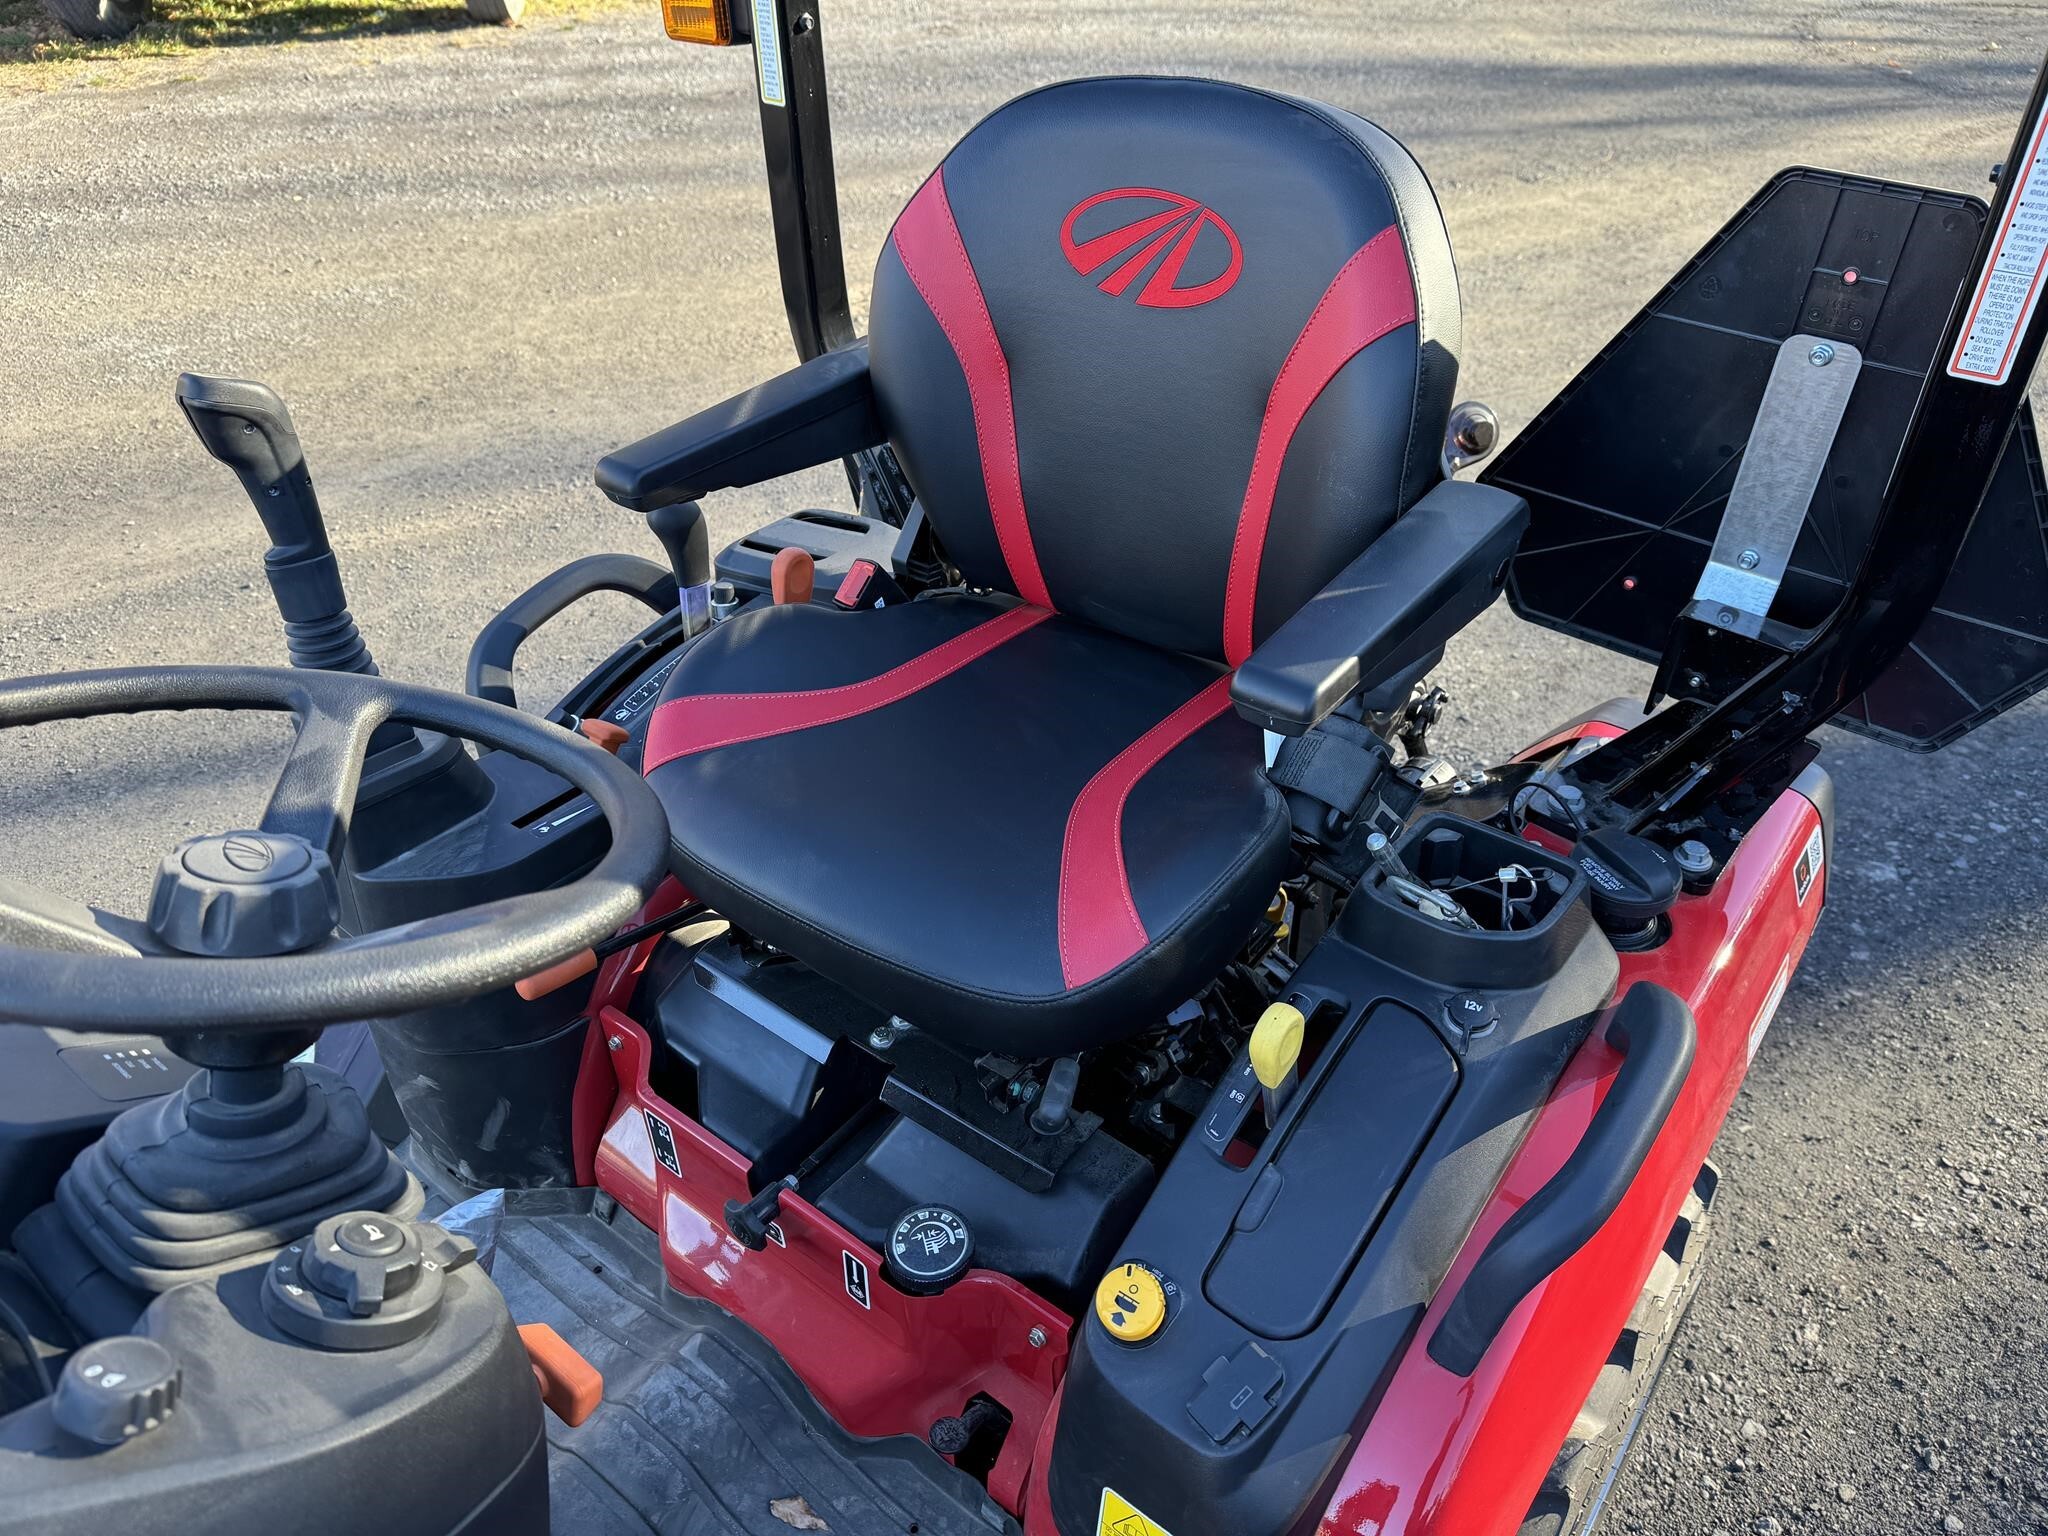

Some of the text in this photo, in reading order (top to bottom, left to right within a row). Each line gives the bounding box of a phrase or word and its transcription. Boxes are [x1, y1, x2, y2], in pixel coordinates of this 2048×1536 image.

[1992, 274, 2008, 283] WHEN
[2008, 276, 2018, 285] THE
[1990, 282, 2027, 294] MUST BE DOWN
[1989, 292, 2007, 300] THERE
[2013, 295, 2022, 304] NO
[1989, 301, 2014, 311] OPERATOR
[1983, 309, 2014, 320] PROTECTION
[1980, 326, 2004, 336] ROLLOVER
[1975, 336, 2003, 347] DO NOT USE
[1972, 344, 1996, 355] SEAT BELT
[1968, 353, 1997, 364] DRIVE WITH
[1966, 362, 1980, 370] EXTRA
[1464, 1000, 1483, 1012] 12v
